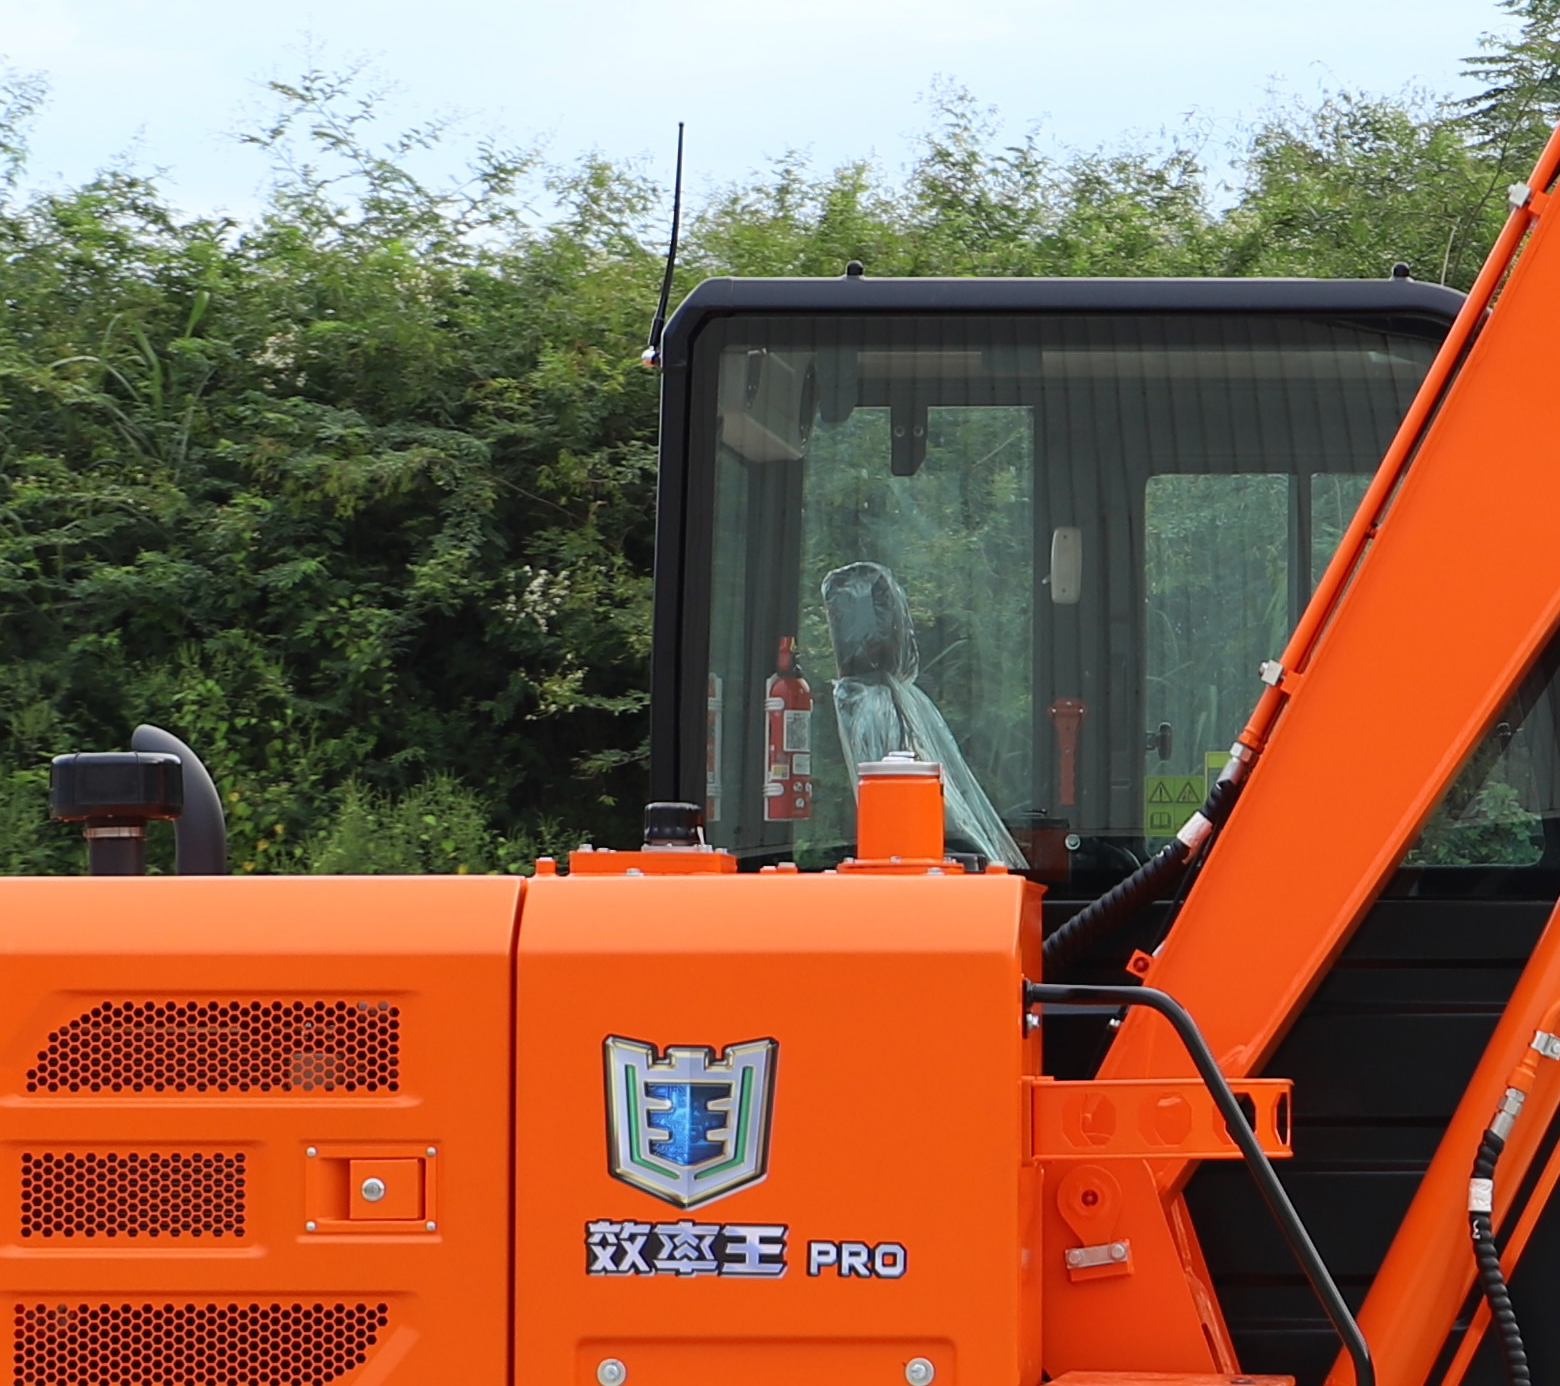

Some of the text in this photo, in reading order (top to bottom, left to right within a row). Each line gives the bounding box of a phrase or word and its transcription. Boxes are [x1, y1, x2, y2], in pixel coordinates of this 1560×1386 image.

[586, 1219, 907, 1279] 效率王 PRO
